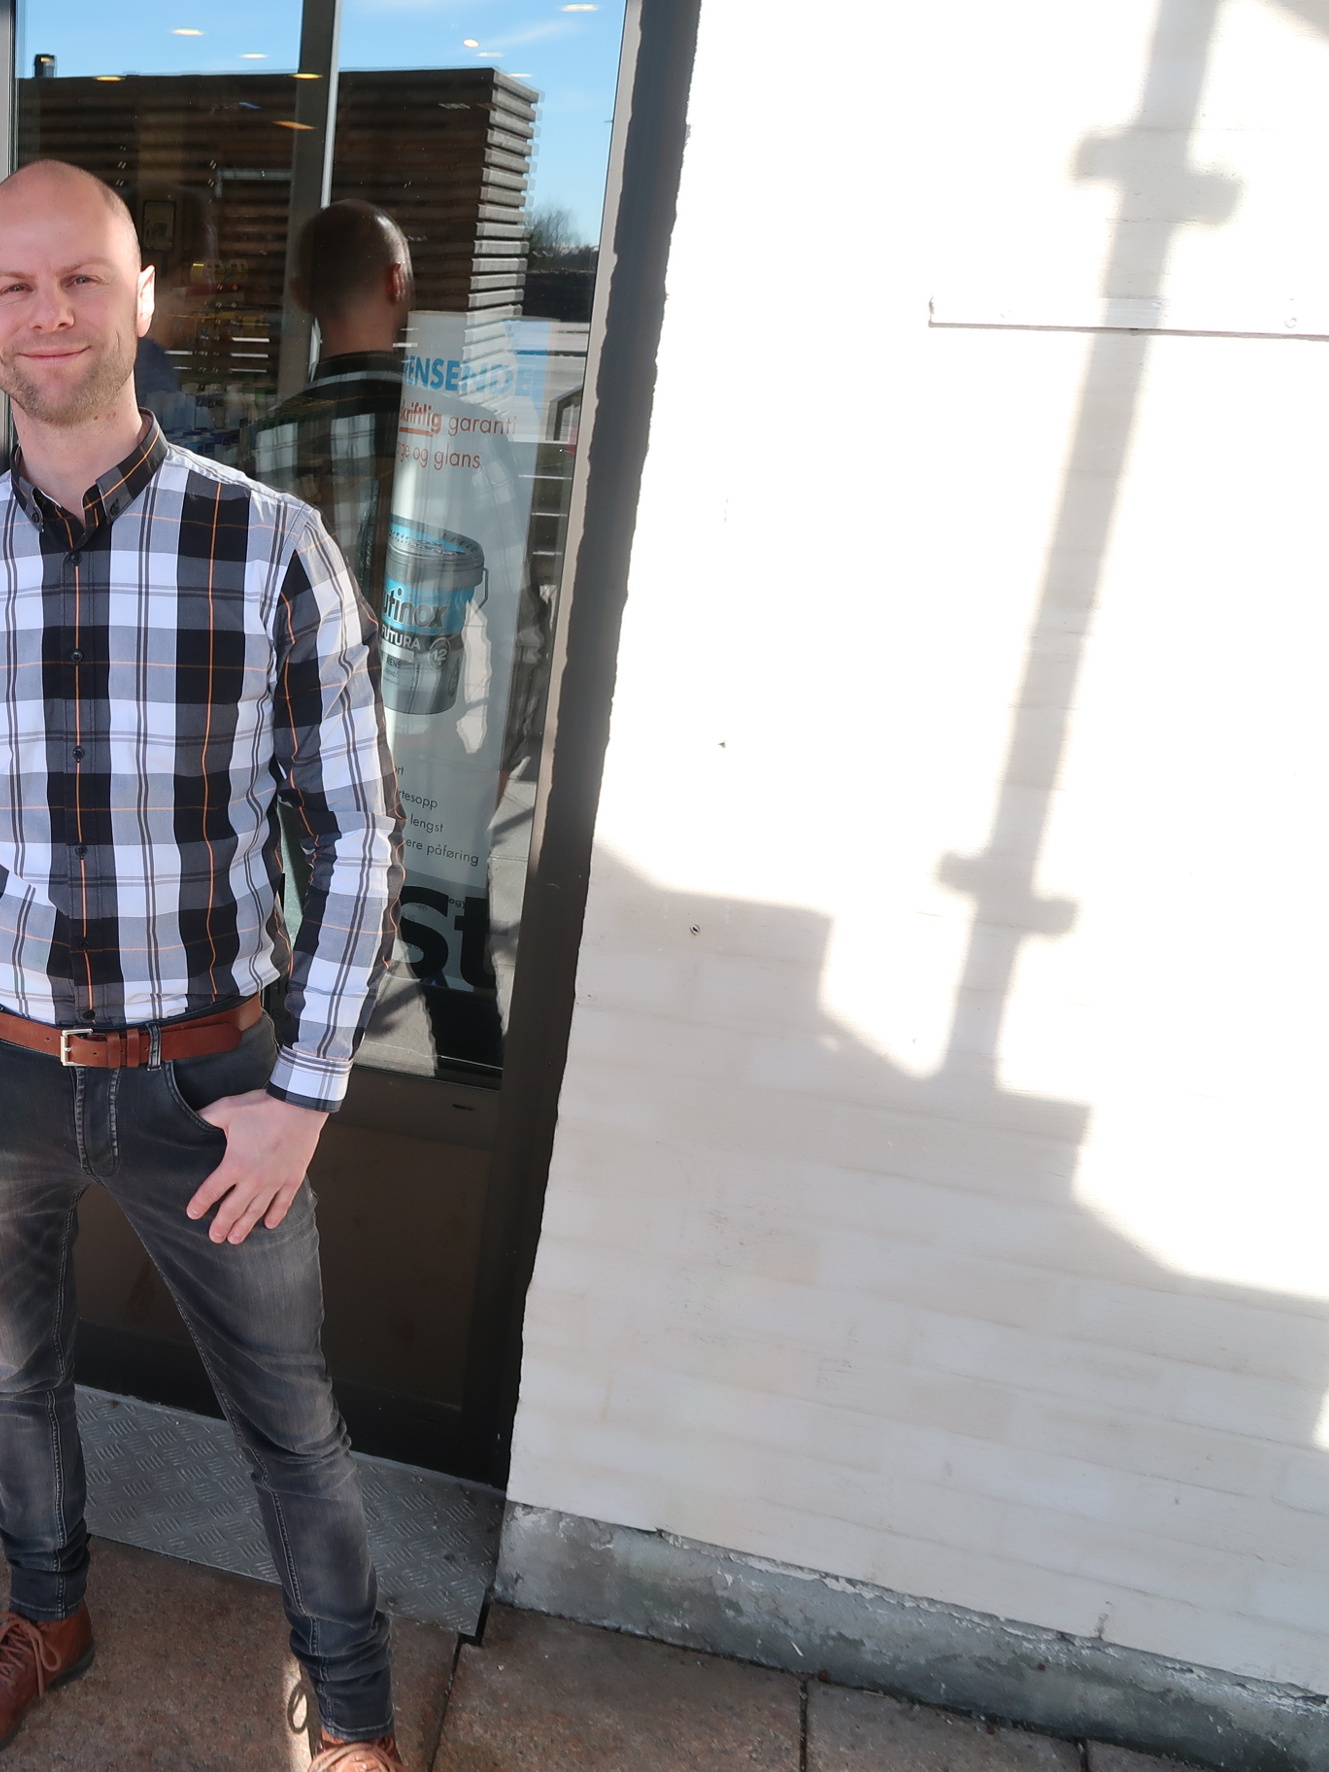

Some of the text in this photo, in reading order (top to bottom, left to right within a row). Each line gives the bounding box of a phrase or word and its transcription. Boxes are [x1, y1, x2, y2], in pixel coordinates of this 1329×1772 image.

[448, 415, 518, 437] garanti
[413, 446, 429, 467] og
[434, 443, 481, 471] glans
[381, 623, 421, 650] FUTURA
[433, 649, 448, 662] 12
[410, 813, 444, 834] lengst
[426, 842, 480, 867] påføring
